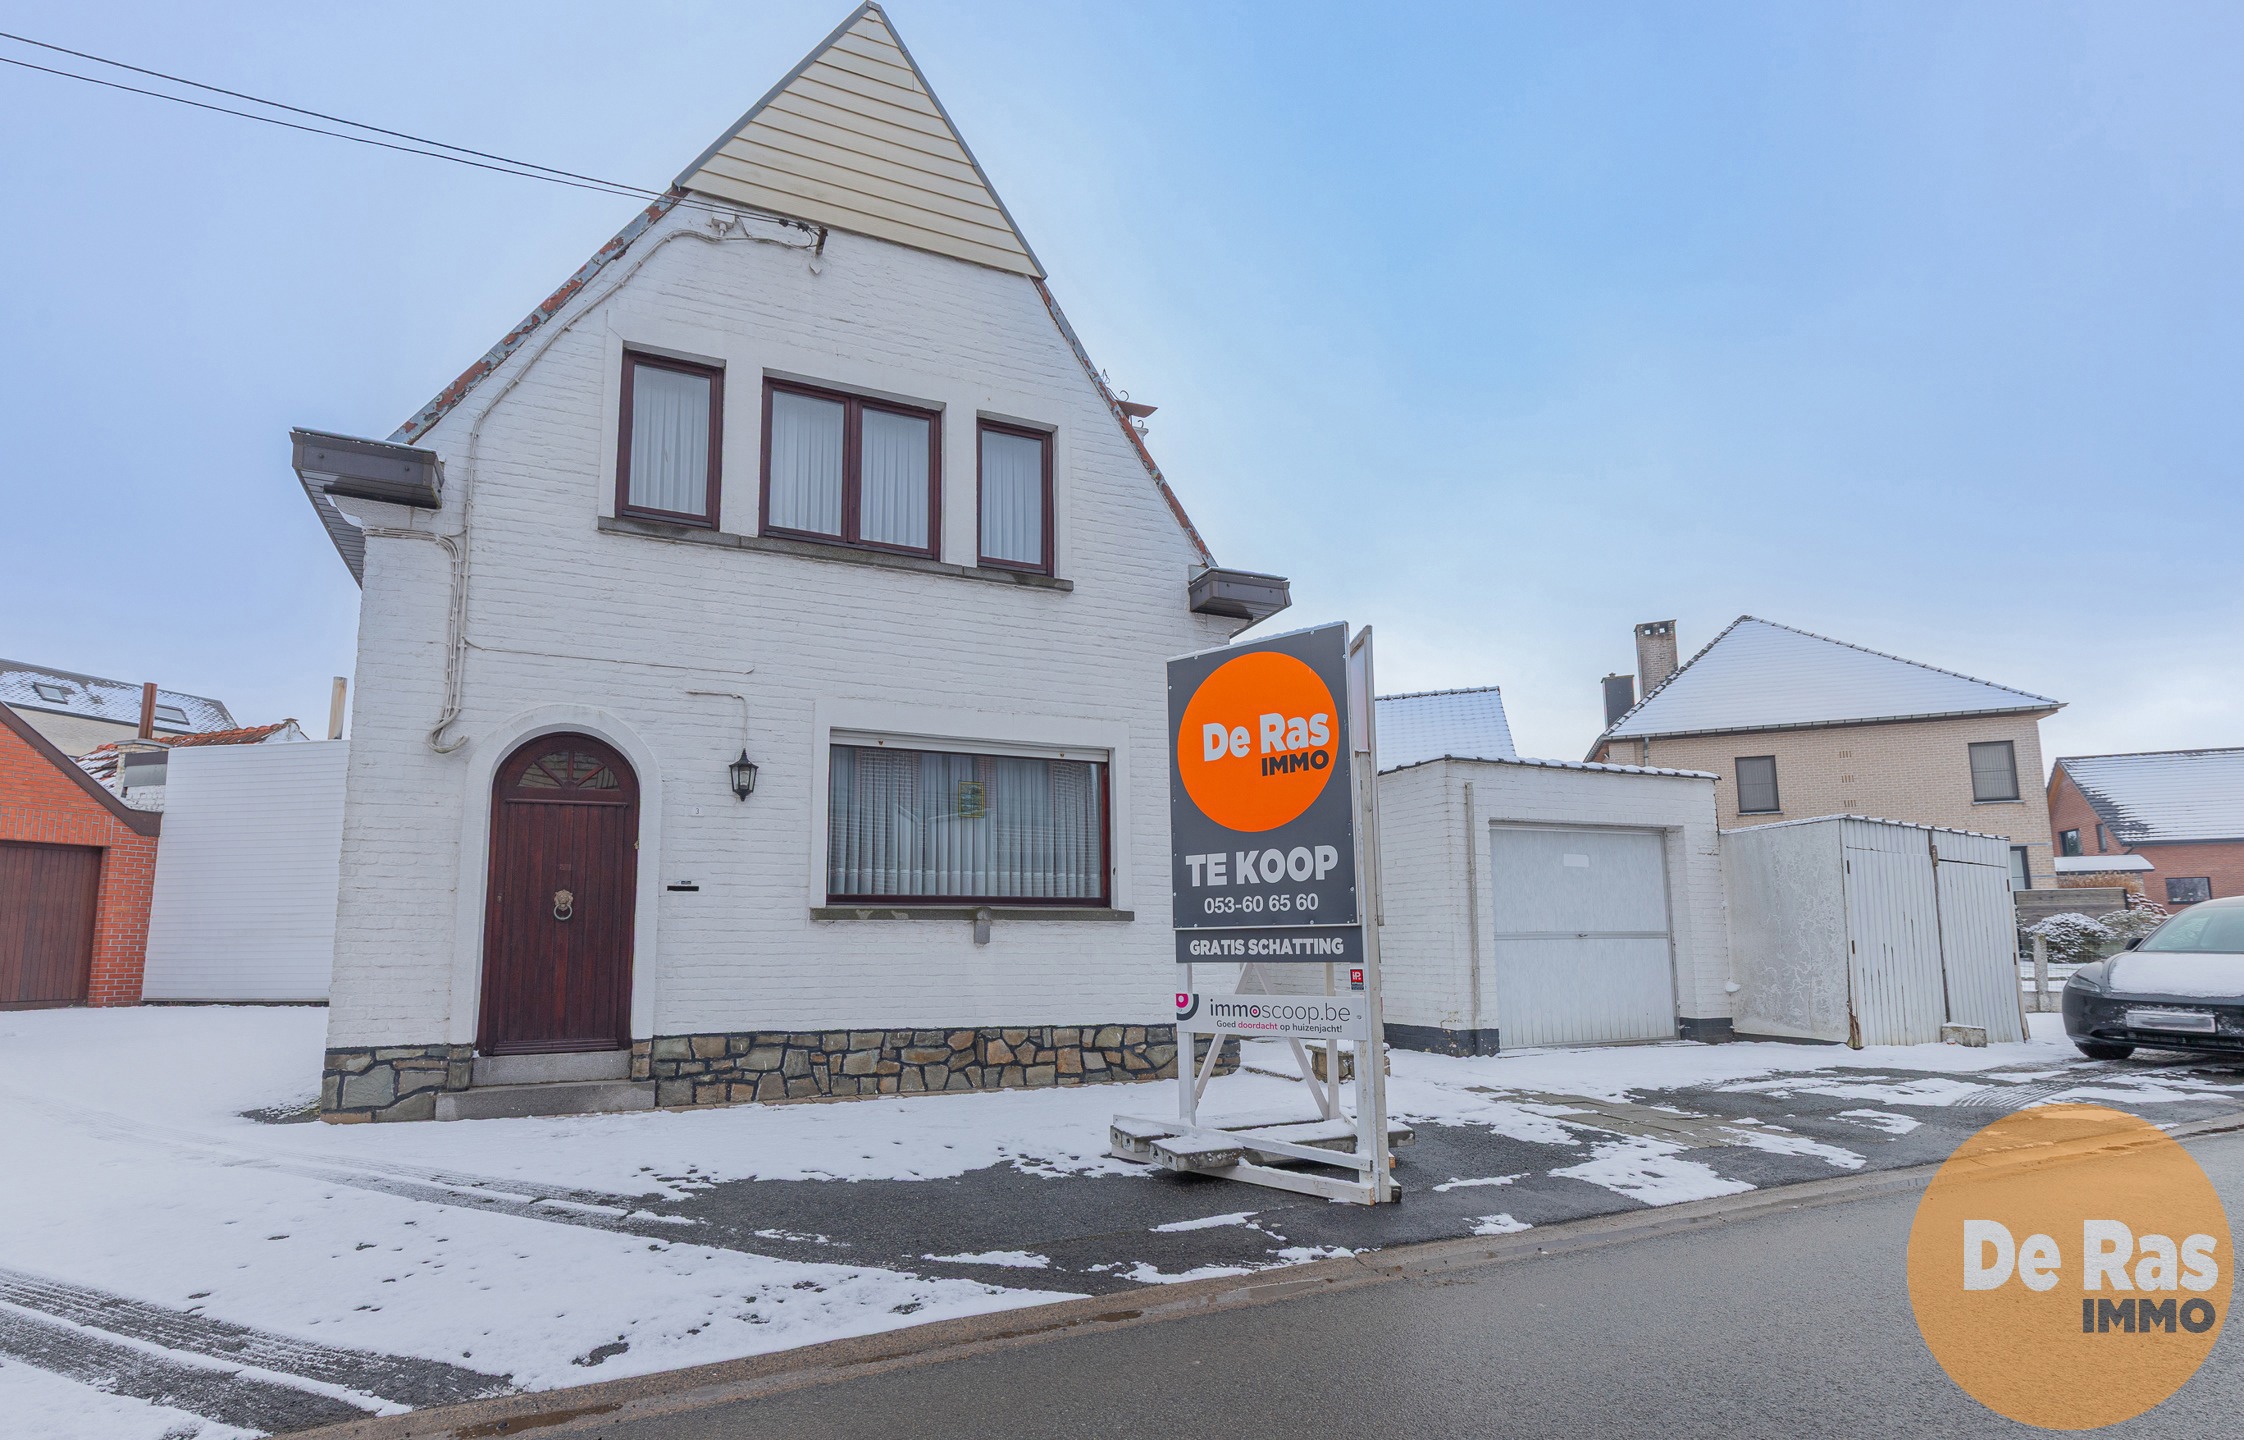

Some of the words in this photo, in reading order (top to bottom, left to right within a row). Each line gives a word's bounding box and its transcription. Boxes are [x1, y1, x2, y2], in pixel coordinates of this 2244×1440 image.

[1203, 722, 1251, 762] De
[1260, 712, 1330, 754] Ras
[1261, 749, 1330, 776] IMMO
[1185, 852, 1228, 887] TE
[1235, 844, 1339, 884] KOOP
[1204, 896, 1264, 914] 053-60
[1268, 894, 1291, 912] 65
[1296, 893, 1319, 911] 60
[1189, 939, 1245, 956] GRATIS
[1247, 937, 1344, 955] SCHATTING
[1210, 998, 1350, 1025] immoscoop.be
[1216, 1019, 1237, 1028] Goed
[1237, 1021, 1278, 1031] doordacht
[1279, 1024, 1291, 1032] op
[1292, 1023, 1343, 1034] huizenjacht!
